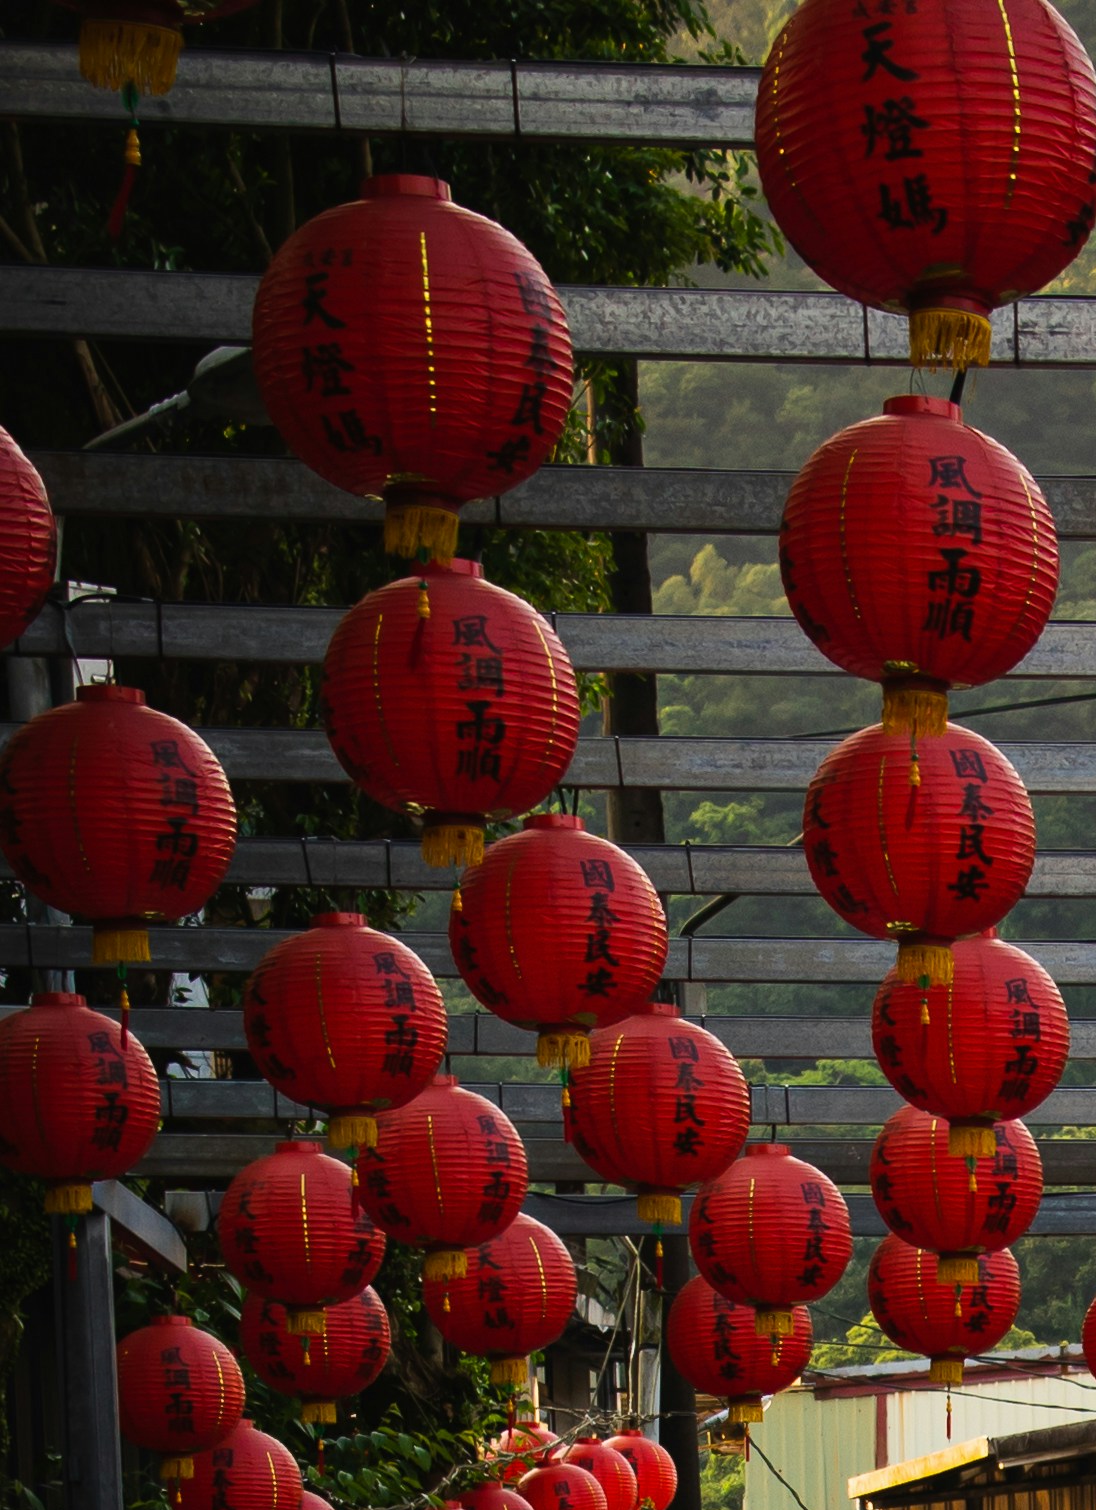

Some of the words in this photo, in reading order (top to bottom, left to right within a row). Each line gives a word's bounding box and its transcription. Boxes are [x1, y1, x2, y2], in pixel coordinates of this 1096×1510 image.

[862, 21, 948, 236] 天燈媽
[302, 271, 383, 455] 天燈媽
[925, 454, 984, 644] 風調雨順
[453, 615, 505, 785] 風調雨順
[150, 740, 203, 892] 風調雨順
[949, 749, 994, 902] 國泰民安
[578, 859, 621, 997] 國泰民安
[373, 952, 418, 1080] 風調雨順
[1000, 977, 1041, 1100] 風調雨順
[88, 1031, 128, 1153] 風調雨順
[668, 1036, 705, 1156] 國泰民安
[799, 1181, 830, 1287] 國泰民安
